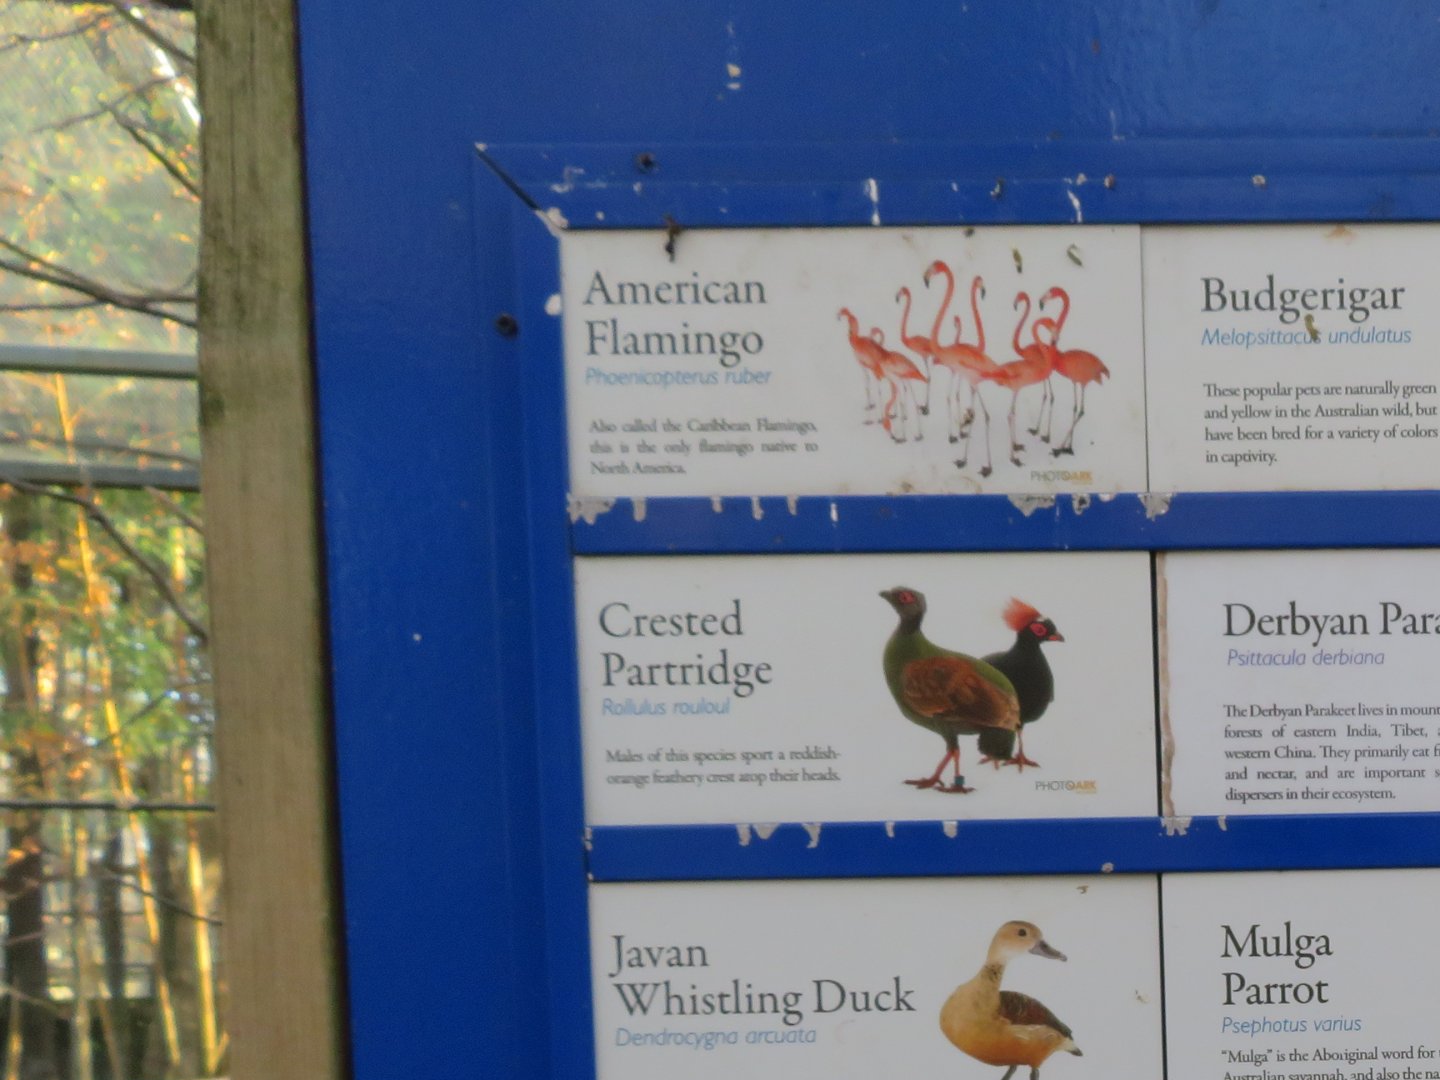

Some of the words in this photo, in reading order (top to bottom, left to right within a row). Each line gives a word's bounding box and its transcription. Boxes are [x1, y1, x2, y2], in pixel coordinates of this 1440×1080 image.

[583, 269, 766, 305] American
[1201, 274, 1405, 322] Budgerigar
[585, 318, 763, 367] Flamingo
[1327, 326, 1412, 344] undulatus
[1202, 383, 1240, 396] These
[1242, 381, 1292, 401] popular
[1295, 386, 1320, 400] pets
[1323, 386, 1341, 395] are
[1344, 380, 1399, 399] naturally
[1402, 384, 1436, 399] green
[598, 598, 743, 637] Crested
[1223, 600, 1368, 646] Derbyan
[601, 648, 771, 696] Partridge
[1227, 647, 1307, 666] Psittacula
[1311, 647, 1385, 665] derbiana
[1223, 704, 1247, 717] The
[1249, 702, 1302, 720] Derbyan
[1304, 702, 1355, 716] Parakeet
[1357, 702, 1383, 716] lives
[1385, 703, 1397, 715] in
[609, 934, 708, 977] Javan
[1220, 920, 1333, 967] Mulga
[613, 979, 802, 1025] Whistling
[812, 975, 915, 1013] Duck
[1222, 972, 1328, 1005] Parrot
[1221, 1015, 1308, 1038] Psephotus
[1312, 1015, 1362, 1031] varius
